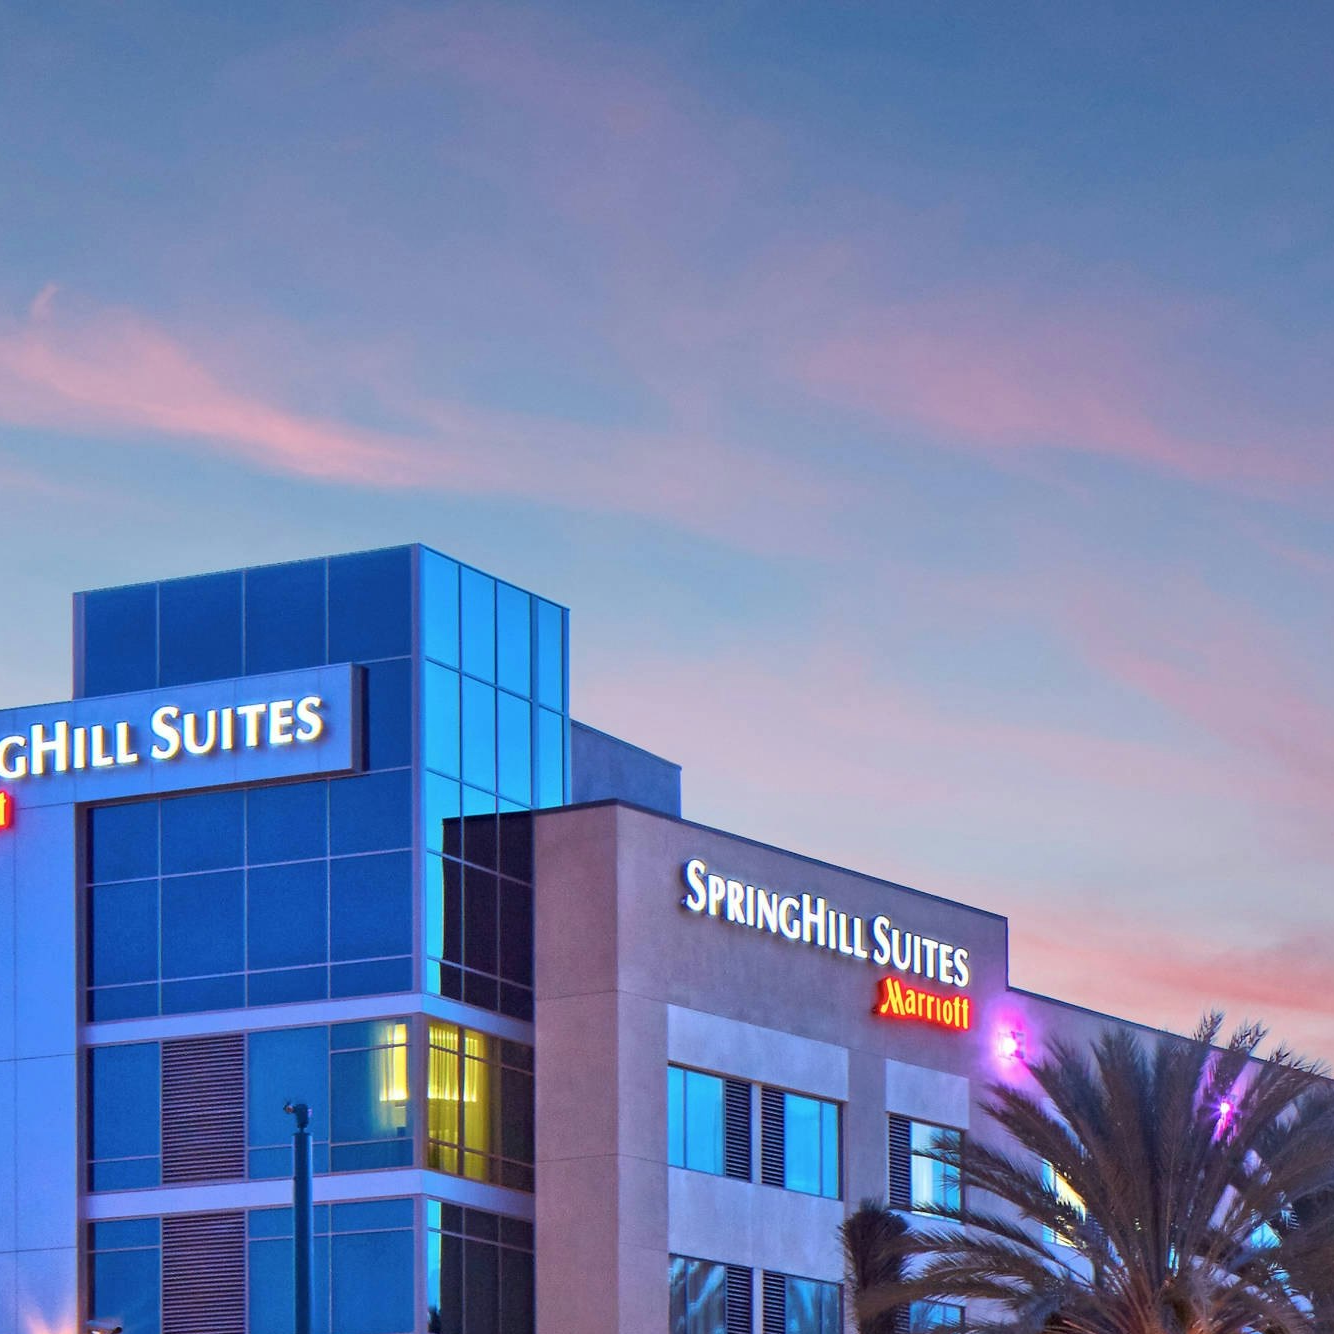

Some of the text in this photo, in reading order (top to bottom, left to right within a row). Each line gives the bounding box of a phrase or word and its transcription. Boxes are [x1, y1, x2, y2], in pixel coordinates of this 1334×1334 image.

[150, 696, 324, 760] SUITES
[871, 915, 971, 988] SUITES
[879, 976, 970, 1030] Marriott
